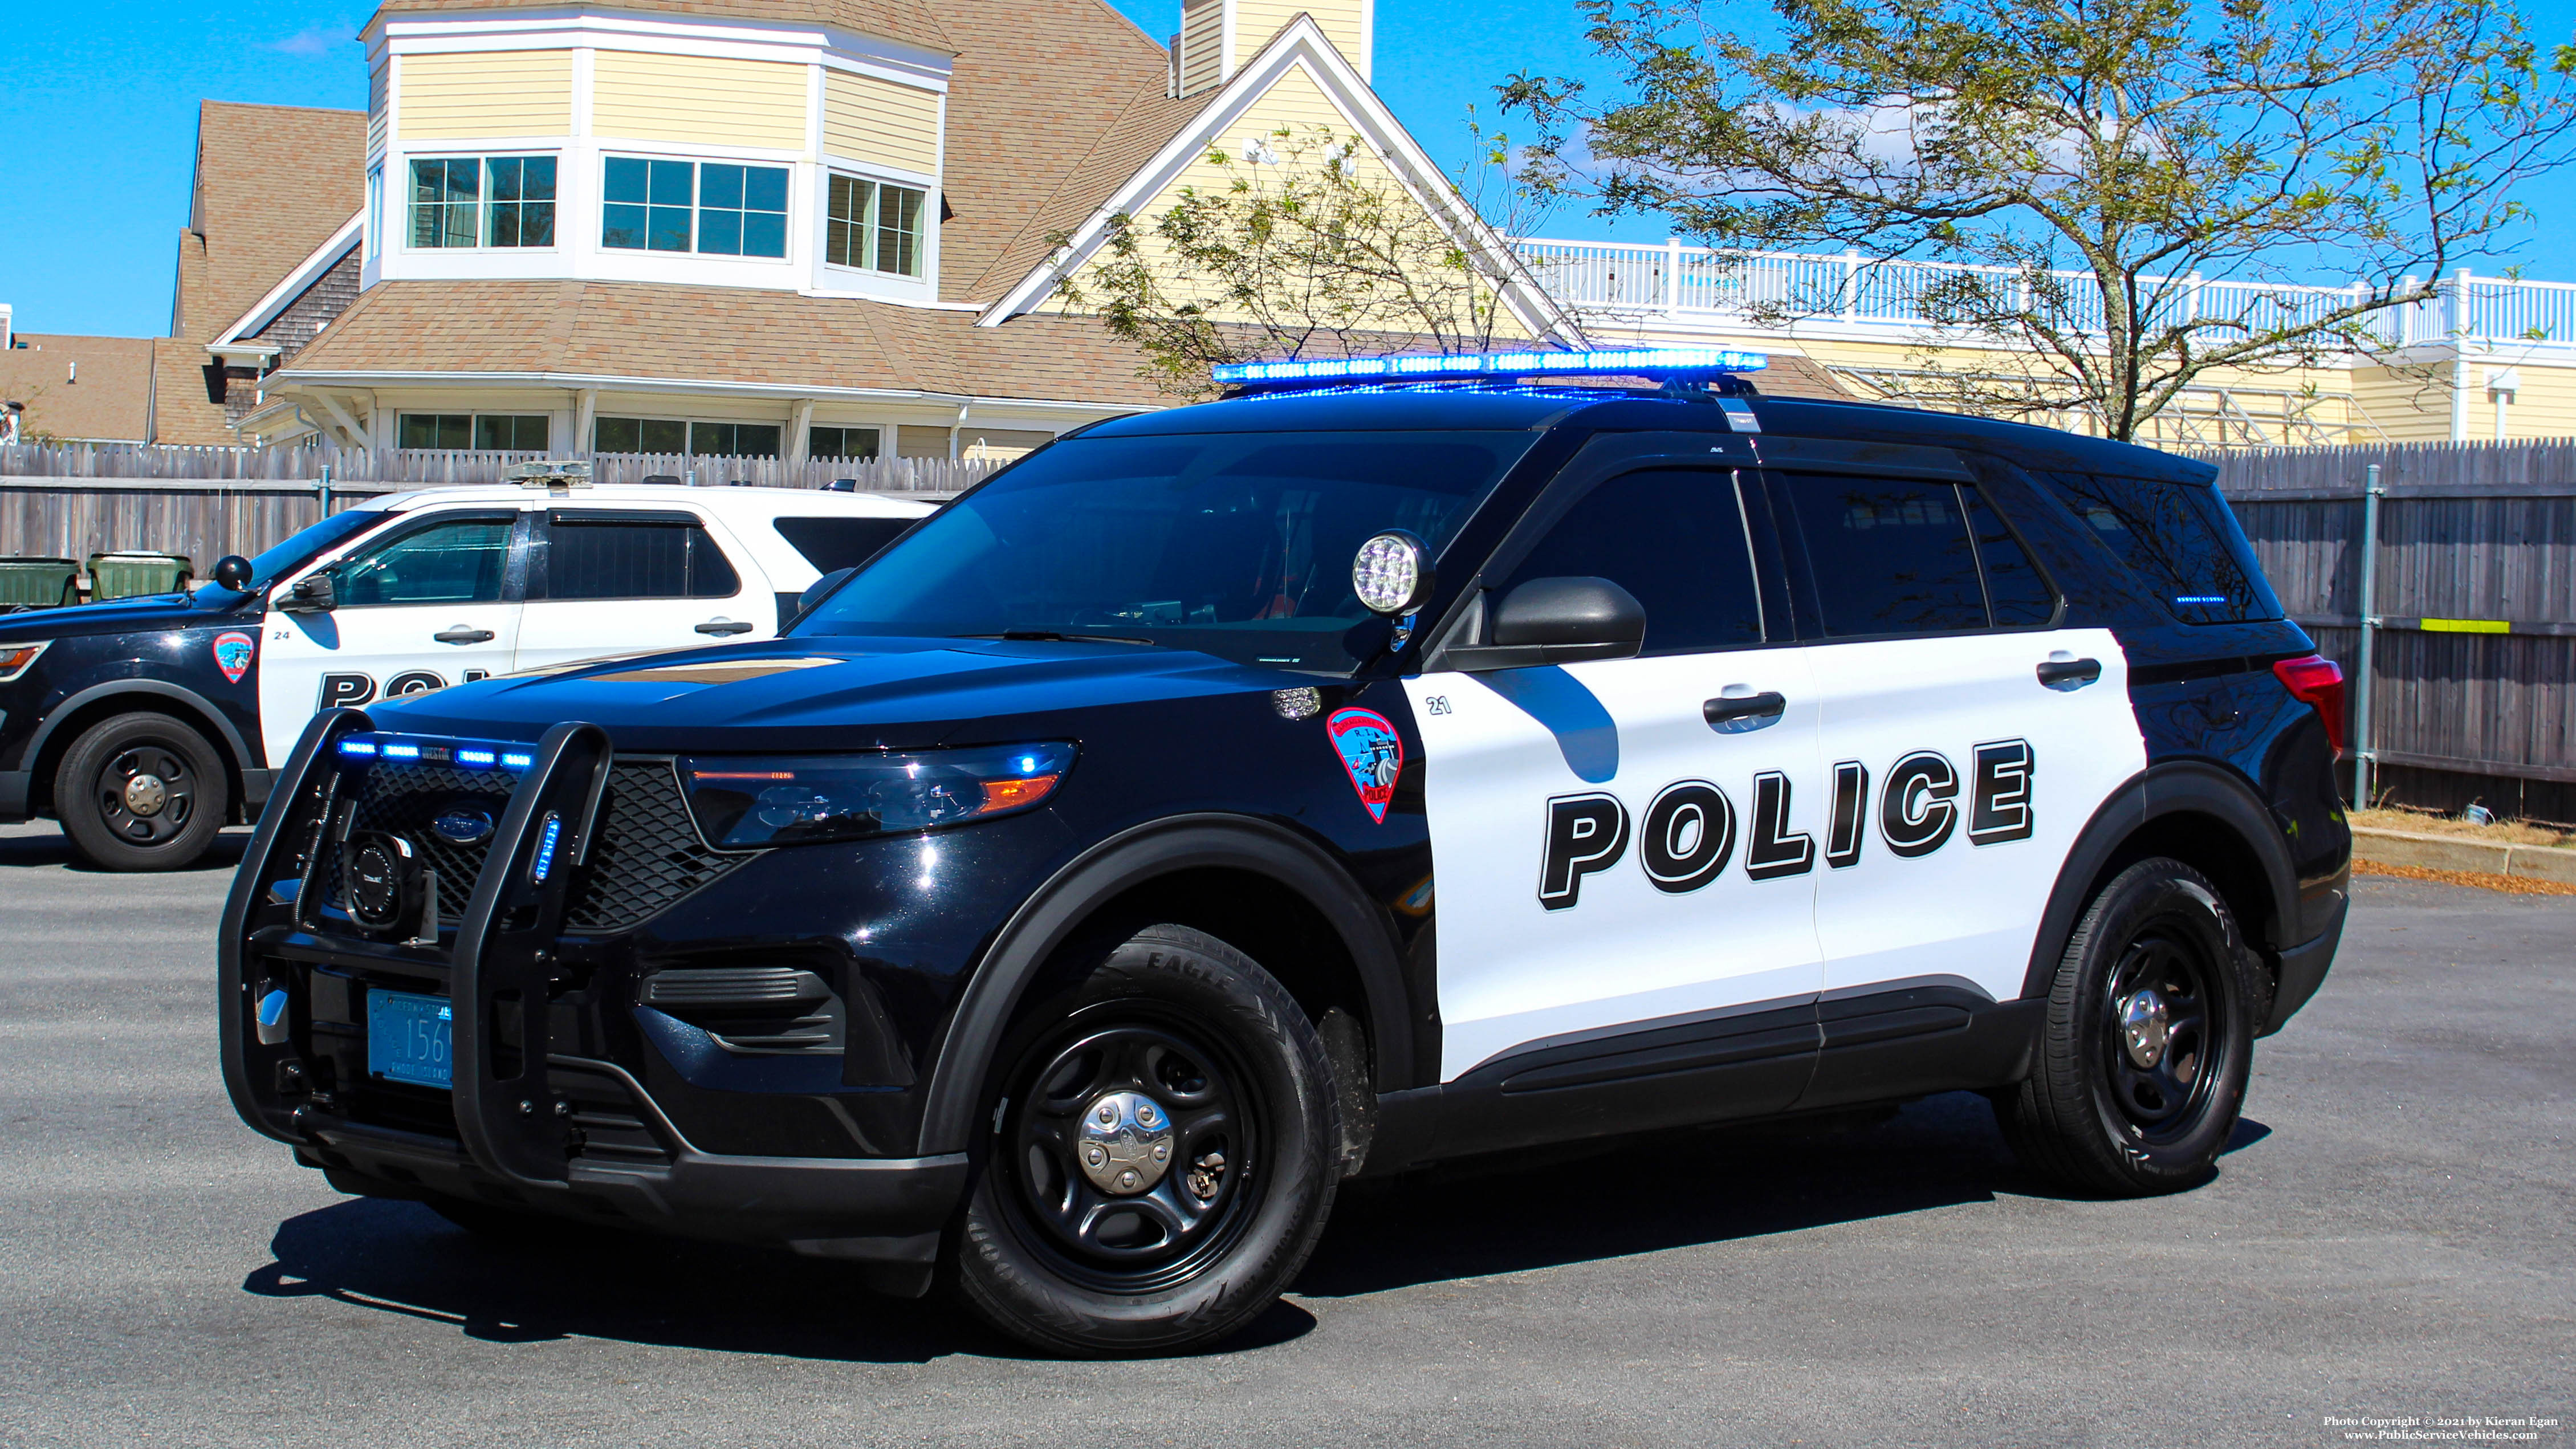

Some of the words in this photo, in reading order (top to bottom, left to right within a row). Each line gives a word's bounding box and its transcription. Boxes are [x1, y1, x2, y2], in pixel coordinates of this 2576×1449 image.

[274, 631, 290, 640] 24
[1426, 695, 1452, 715] 21
[422, 746, 450, 760] WESTIN
[1364, 788, 1387, 801] POLICE
[1537, 737, 2034, 912] POLICE
[1146, 951, 1234, 991] EAGLE
[406, 1019, 452, 1063] 156
